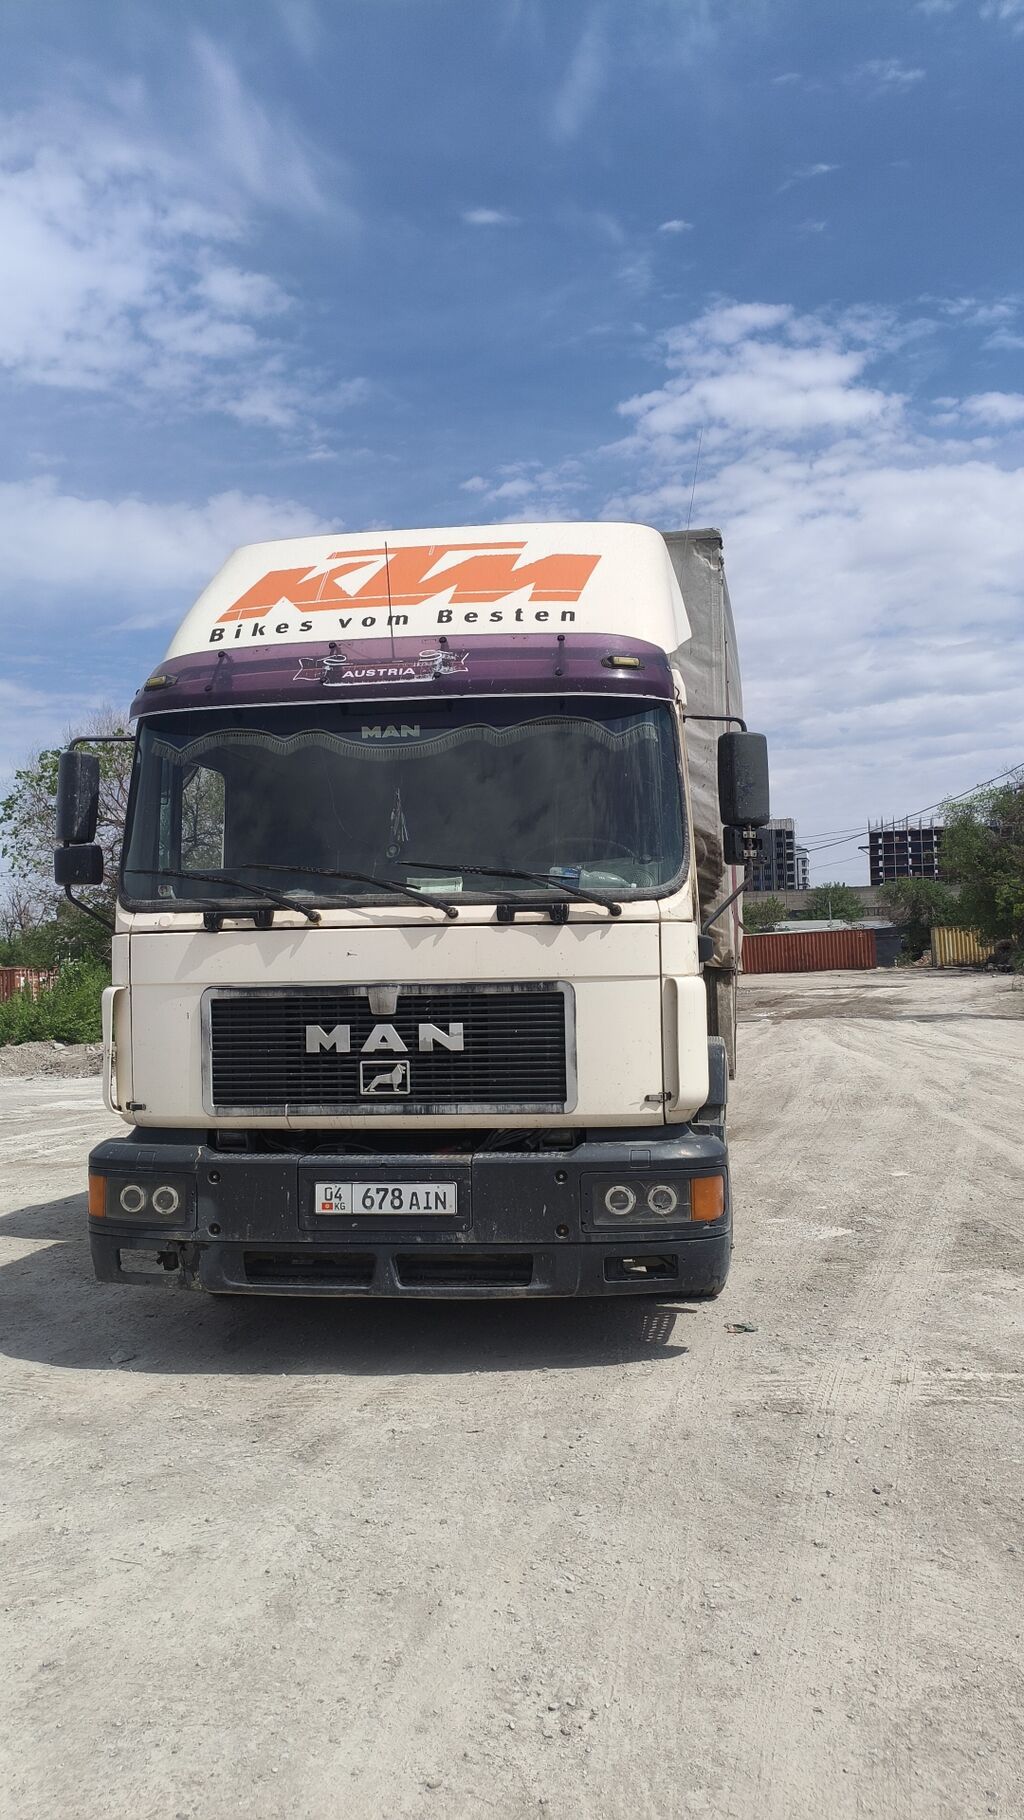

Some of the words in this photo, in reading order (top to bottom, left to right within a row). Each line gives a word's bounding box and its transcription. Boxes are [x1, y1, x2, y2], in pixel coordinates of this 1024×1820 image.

[214, 541, 602, 624] KTM
[208, 619, 313, 643] Bikes
[338, 614, 409, 629] vom
[437, 608, 576, 624] Besten
[342, 667, 416, 679] AUSTRIA
[361, 724, 421, 739] MAN
[305, 1022, 465, 1053] MAN
[324, 1187, 343, 1201] 04
[361, 1187, 404, 1210] 678
[409, 1191, 447, 1210] AIN
[334, 1202, 346, 1211] KG
